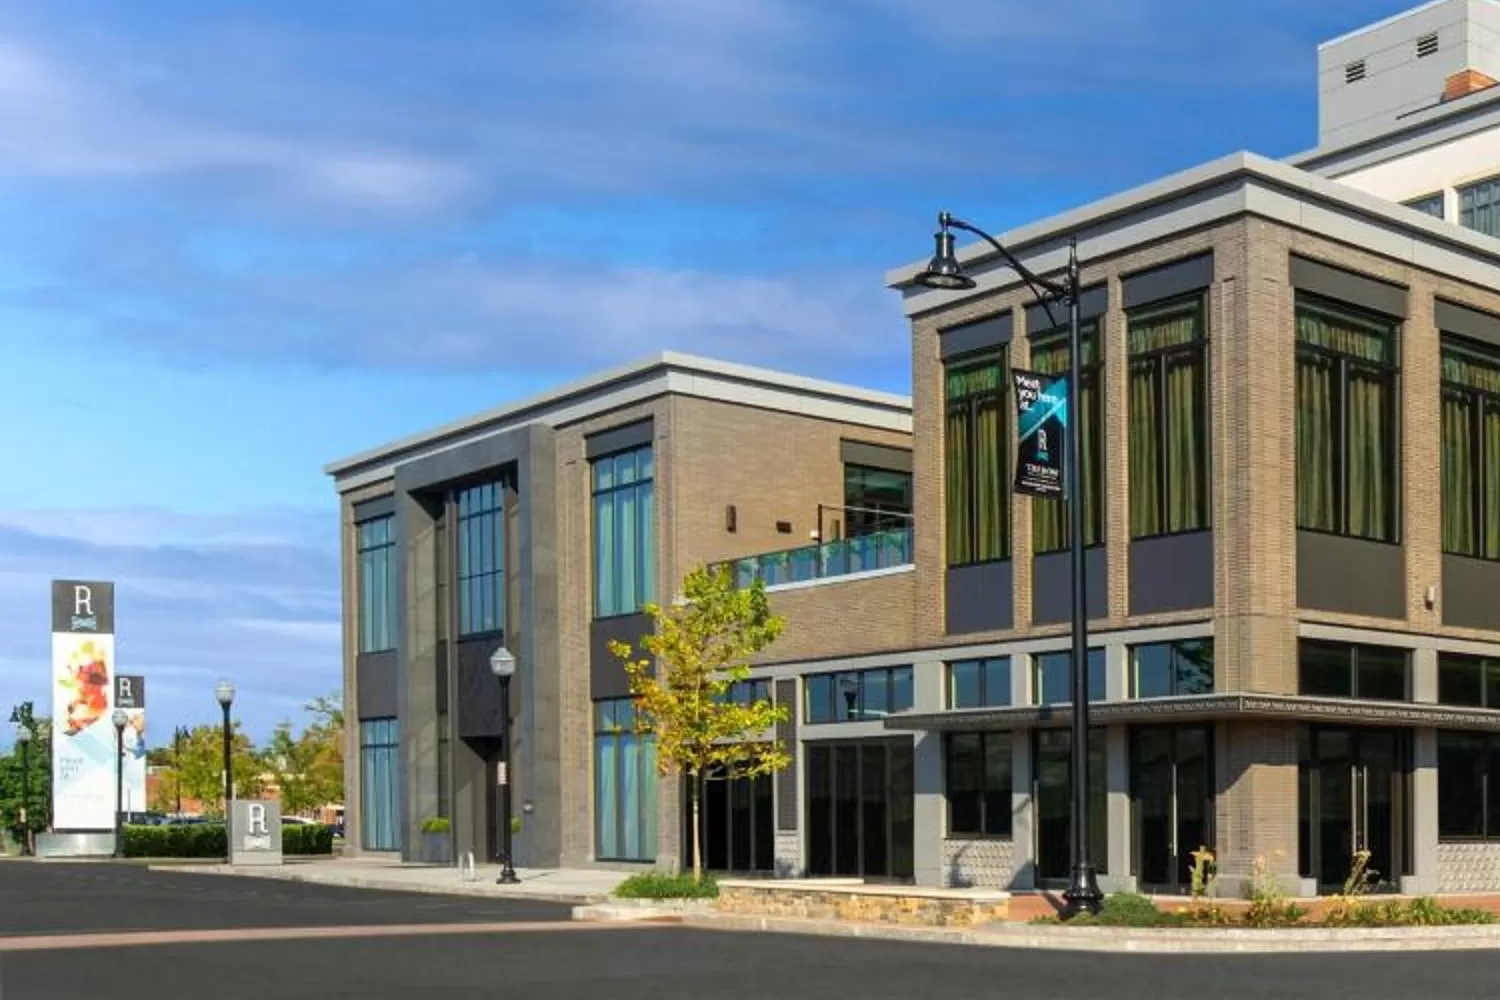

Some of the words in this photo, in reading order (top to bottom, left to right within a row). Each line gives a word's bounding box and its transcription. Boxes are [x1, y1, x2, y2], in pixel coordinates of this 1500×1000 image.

[75, 585, 94, 615] R
[119, 677, 132, 697] R
[248, 803, 269, 833] R
